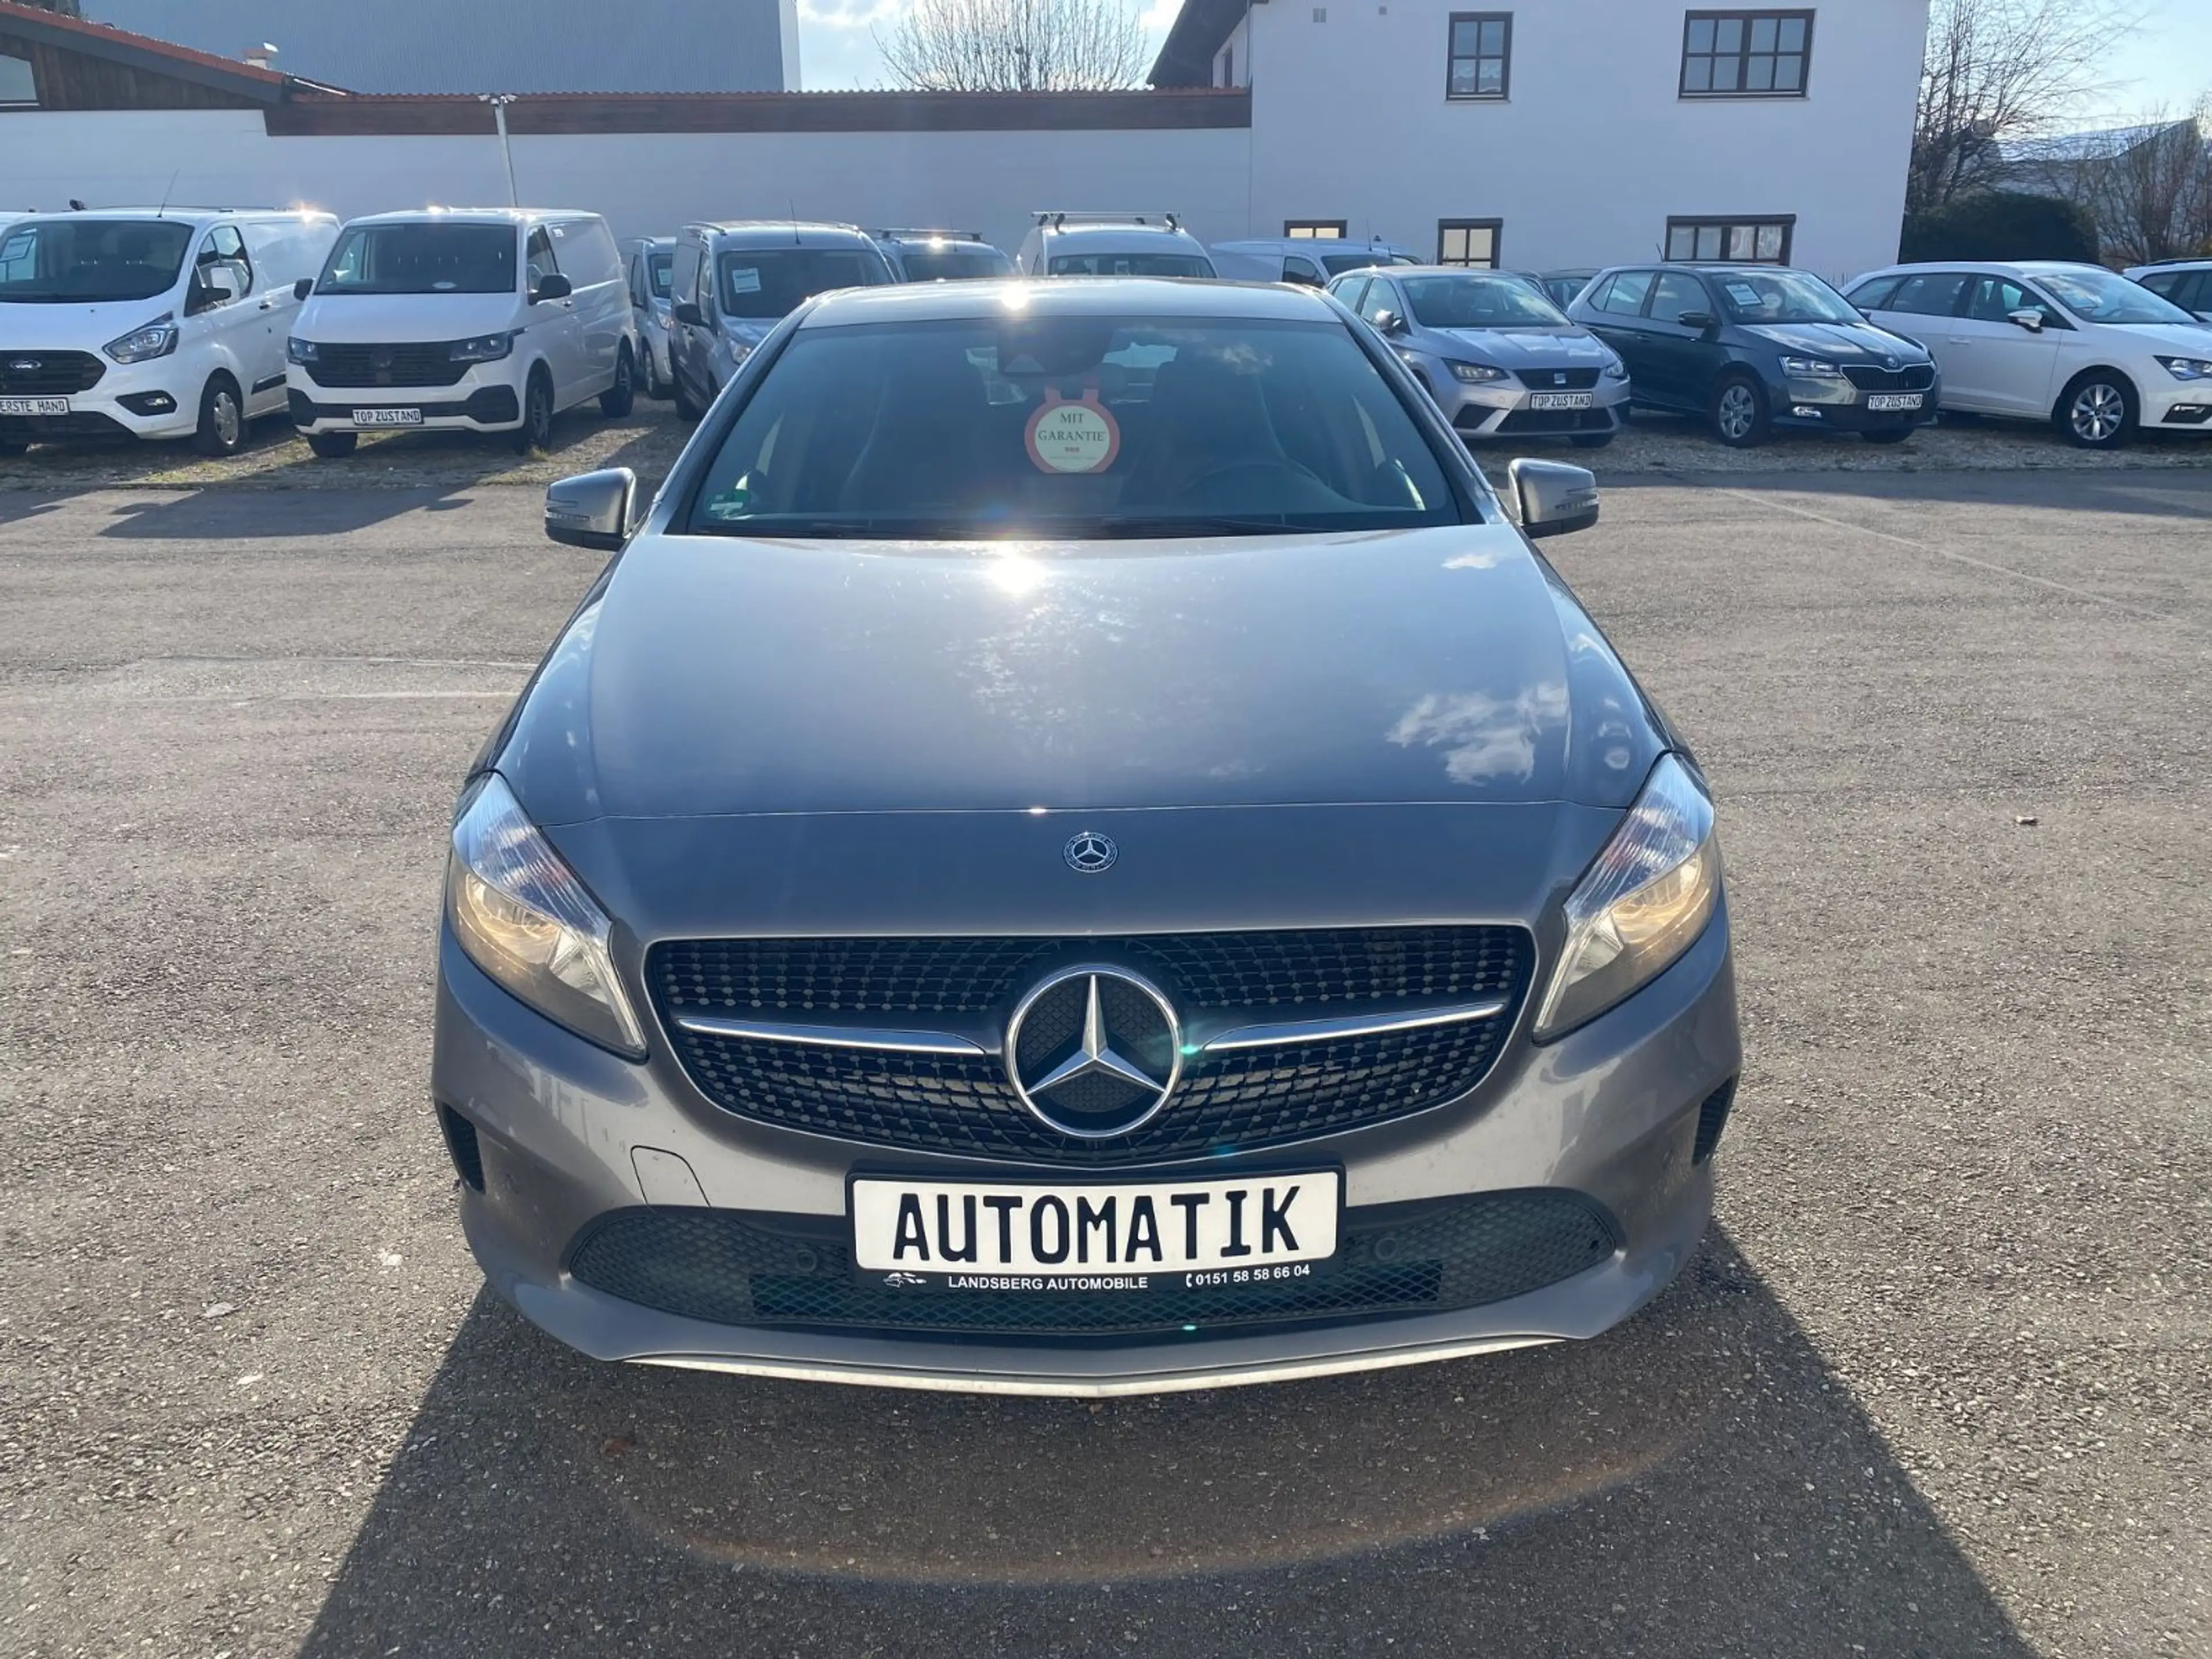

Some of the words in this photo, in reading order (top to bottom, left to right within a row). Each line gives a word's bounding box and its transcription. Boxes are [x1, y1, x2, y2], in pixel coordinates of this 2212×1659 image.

[37, 400, 65, 411] HAND
[1533, 396, 1550, 408] TOP
[1551, 395, 1590, 407] ZUSTAND
[354, 411, 373, 422] TOP
[376, 410, 419, 422] ZUSTAND
[1060, 412, 1084, 424] MIT
[1038, 430, 1107, 442] GARANTIE
[893, 1185, 1301, 1264] AUTOMATIK
[948, 1275, 1043, 1290] LANDSBERG
[1046, 1277, 1149, 1290] AUTOMOBILE
[1195, 1272, 1227, 1286] 0151
[1233, 1270, 1249, 1283] 58
[1253, 1268, 1270, 1281] 58
[1274, 1266, 1290, 1279] 66
[1294, 1264, 1310, 1277] 04
